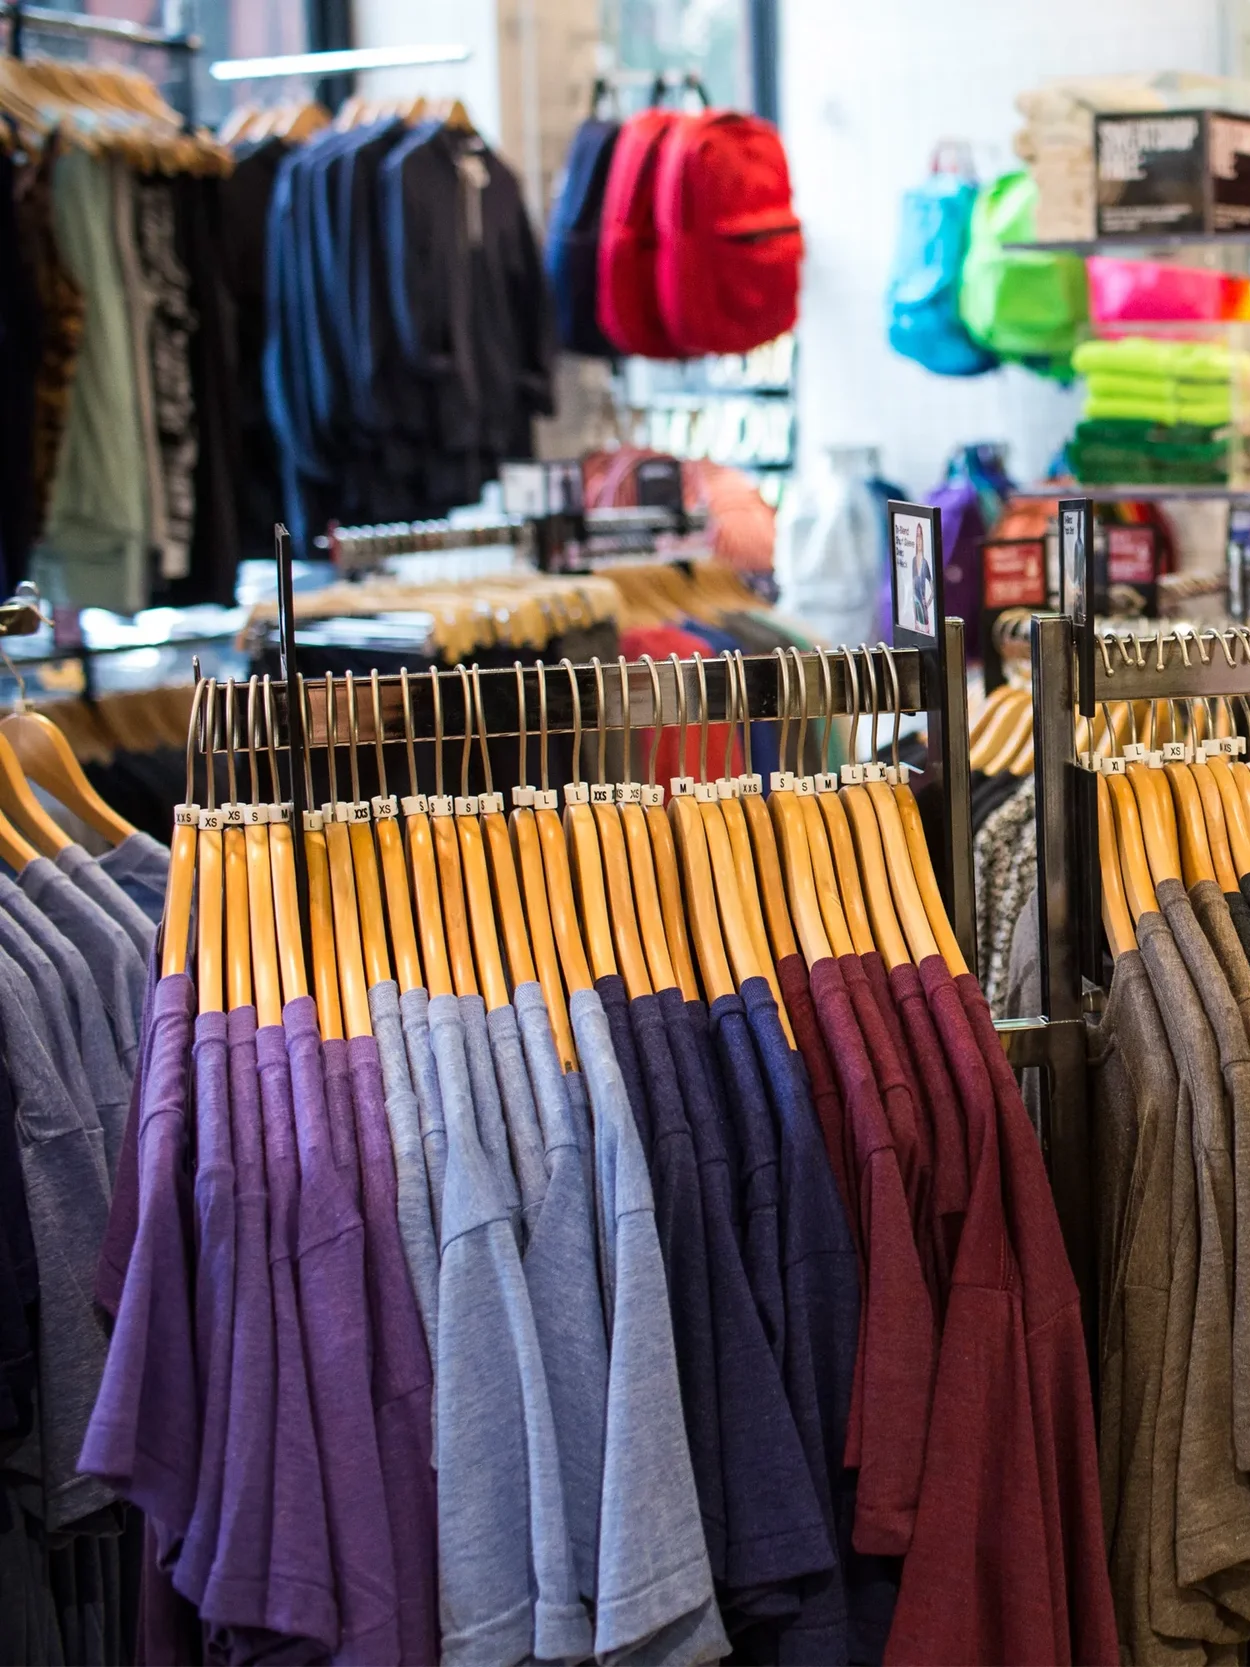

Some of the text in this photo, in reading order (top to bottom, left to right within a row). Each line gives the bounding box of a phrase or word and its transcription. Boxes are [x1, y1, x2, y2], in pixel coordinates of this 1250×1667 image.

[1135, 746, 1142, 756] L
[1170, 746, 1181, 757] XS
[680, 783, 687, 793] M
[780, 778, 785, 788] S
[802, 782, 808, 791] S
[825, 780, 832, 789] M
[707, 788, 712, 798] L
[743, 784, 758, 793] XXS
[575, 791, 581, 800] L
[593, 790, 607, 801] XXS
[629, 789, 640, 799] XS
[652, 793, 658, 803] S
[543, 795, 549, 805] L
[379, 804, 392, 814] XS
[430, 802, 436, 813] S
[466, 802, 472, 812] S
[175, 812, 192, 823] XXS
[228, 810, 240, 820] XS
[251, 812, 259, 822] S
[281, 809, 289, 819] M
[354, 808, 369, 819] XXS
[205, 817, 218, 828] XS
[309, 819, 315, 828] L
